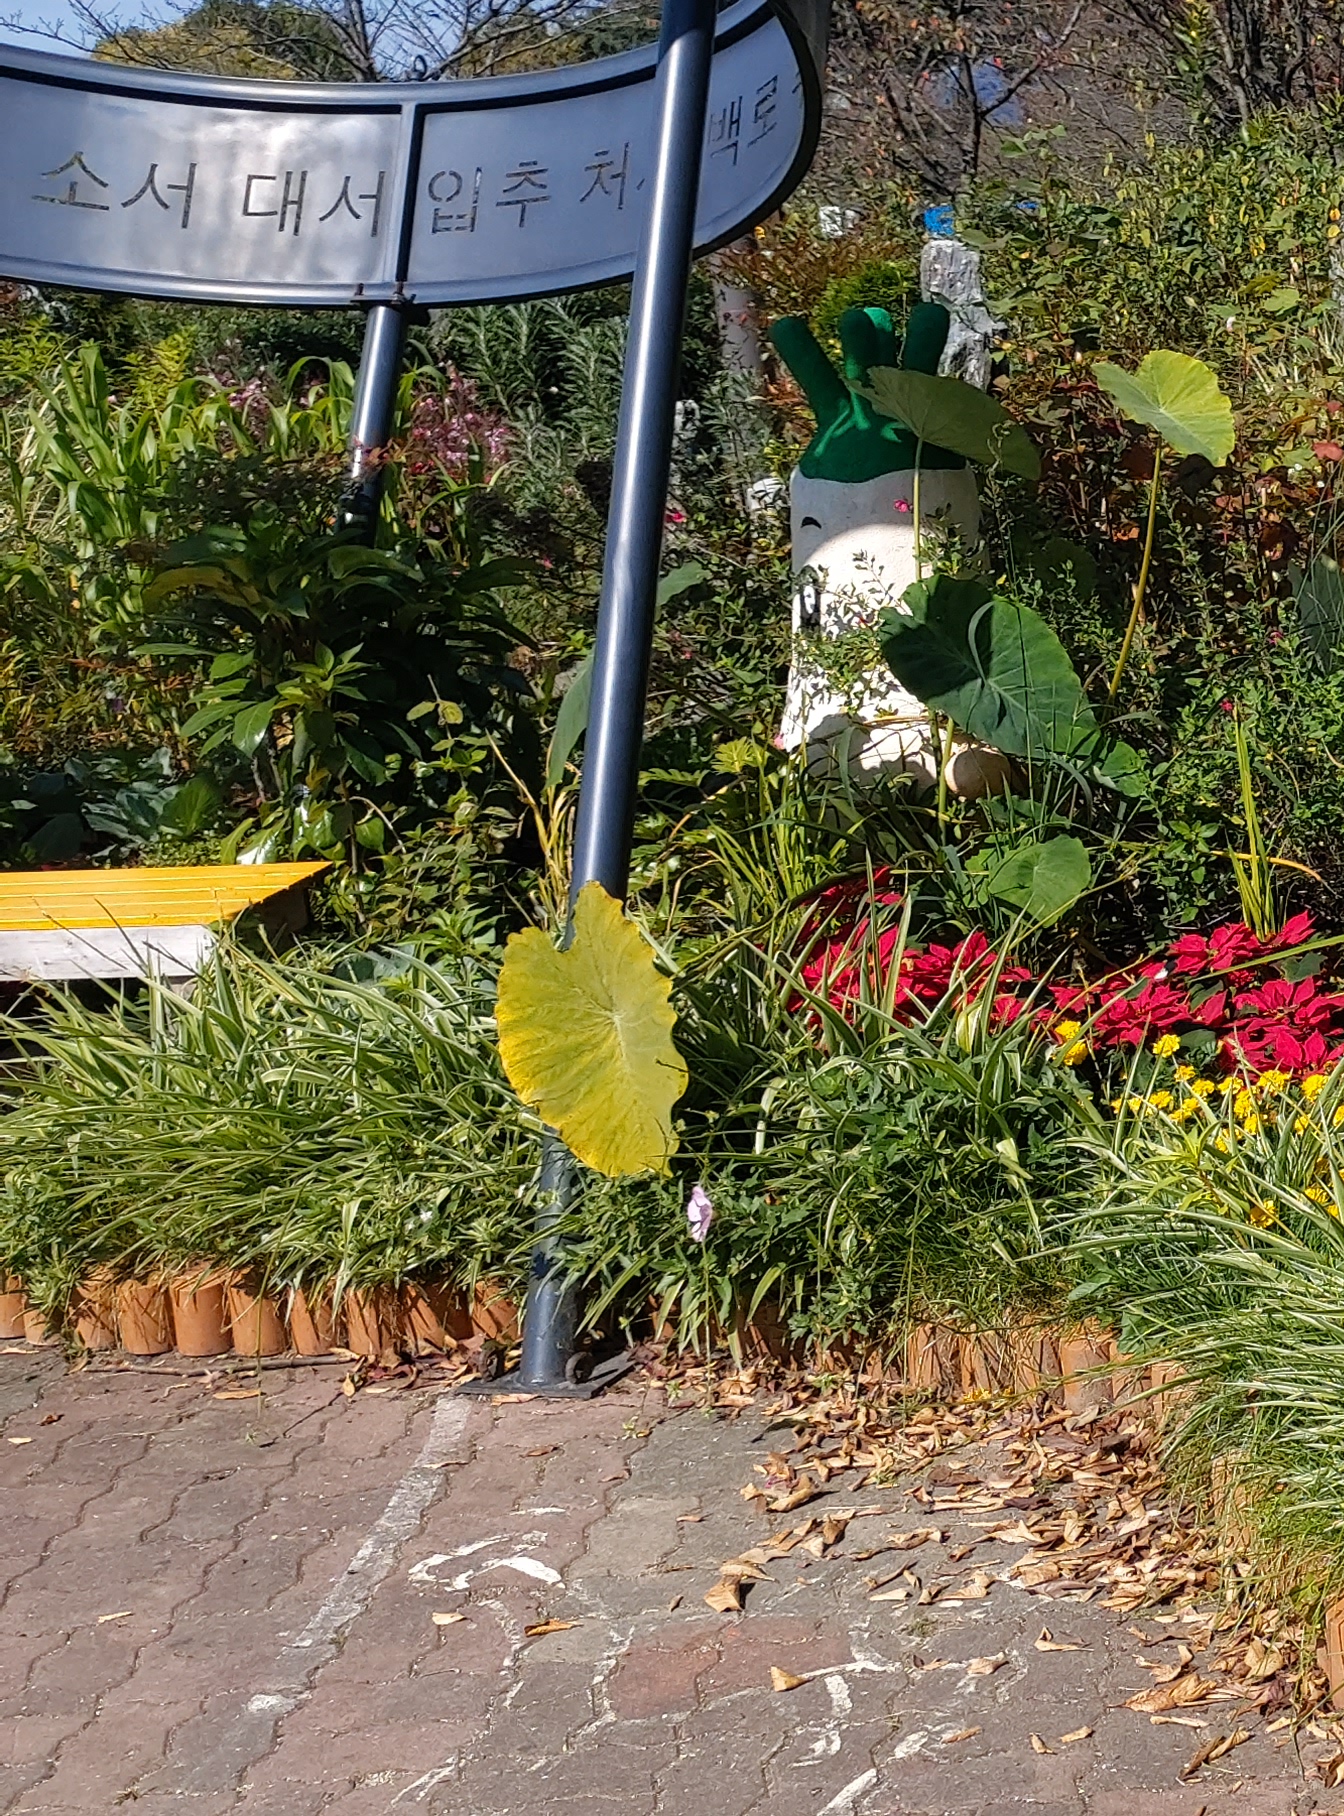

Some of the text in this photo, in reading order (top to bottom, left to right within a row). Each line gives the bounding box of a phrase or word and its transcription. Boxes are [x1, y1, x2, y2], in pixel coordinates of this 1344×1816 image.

[31, 74, 779, 238] 소서 대서 입추 처 백로
